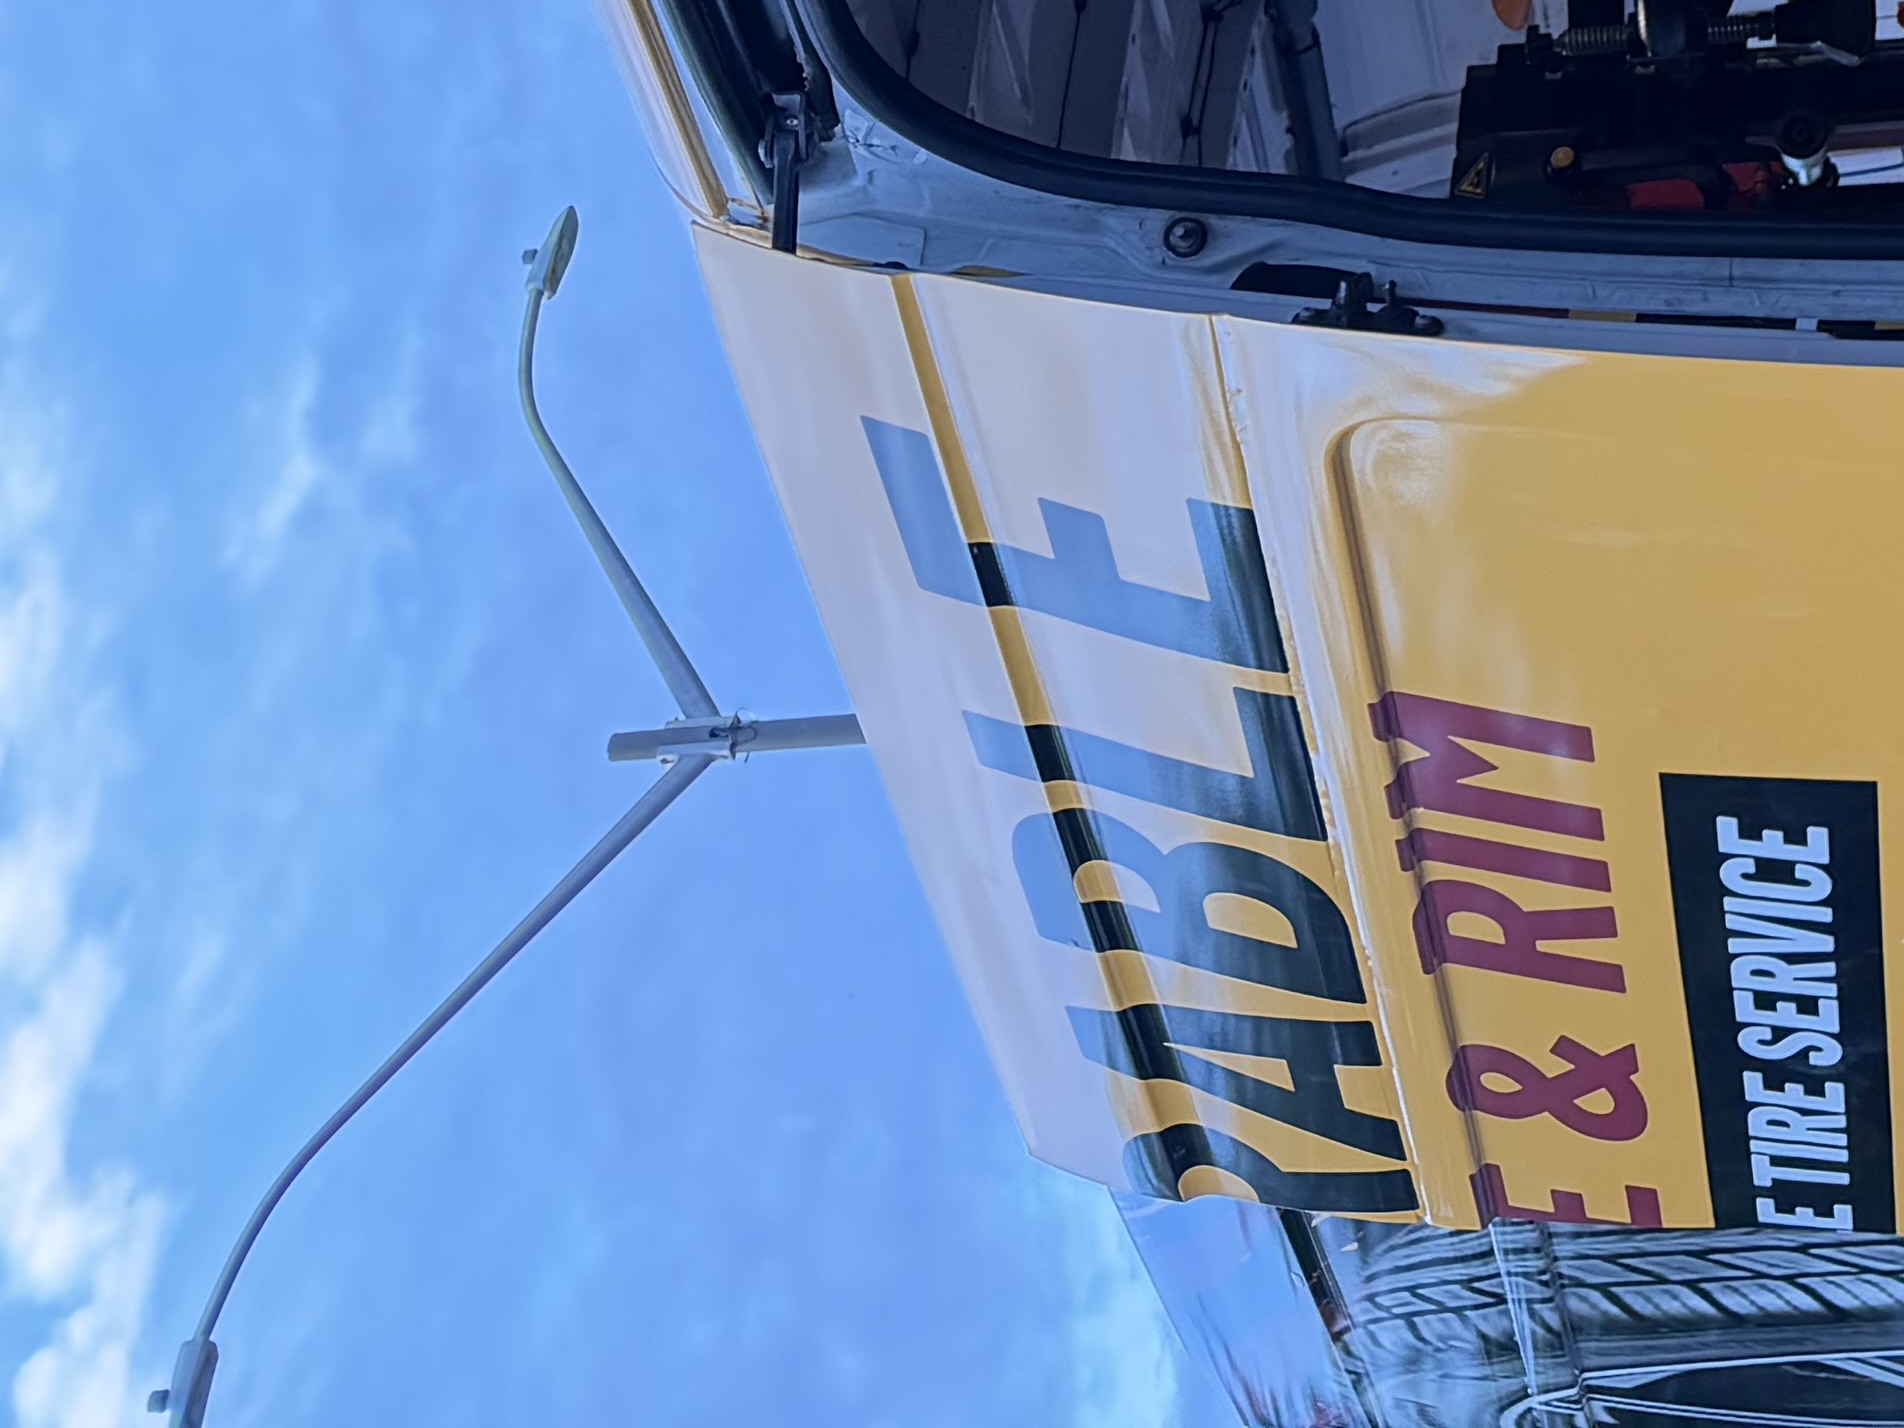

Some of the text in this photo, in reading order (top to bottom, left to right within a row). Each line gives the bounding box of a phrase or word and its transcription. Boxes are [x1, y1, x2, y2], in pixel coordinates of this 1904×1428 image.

[1369, 691, 1663, 1228] E & RIM
[1715, 814, 1854, 1230] E TIRE SERVICE
